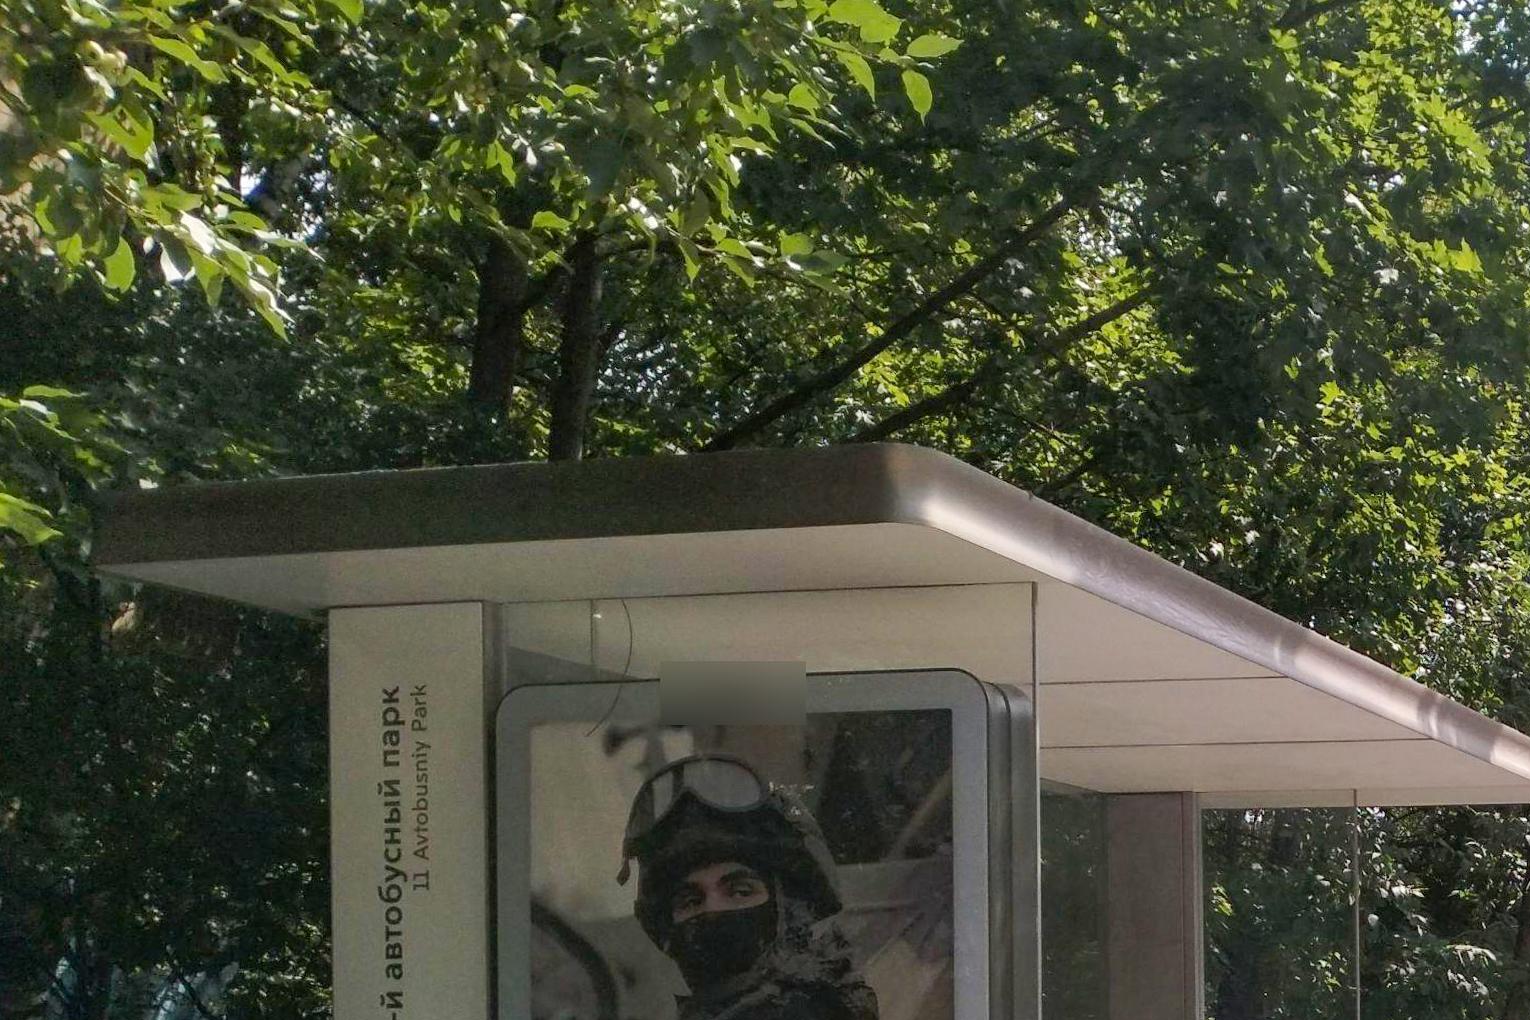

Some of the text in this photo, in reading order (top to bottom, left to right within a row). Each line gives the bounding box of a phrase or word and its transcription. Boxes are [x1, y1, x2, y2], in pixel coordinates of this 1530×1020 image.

[382, 685, 406, 768] парк
[411, 684, 431, 891] 11 Avtobusniy Park
[377, 779, 408, 981] автобусный
